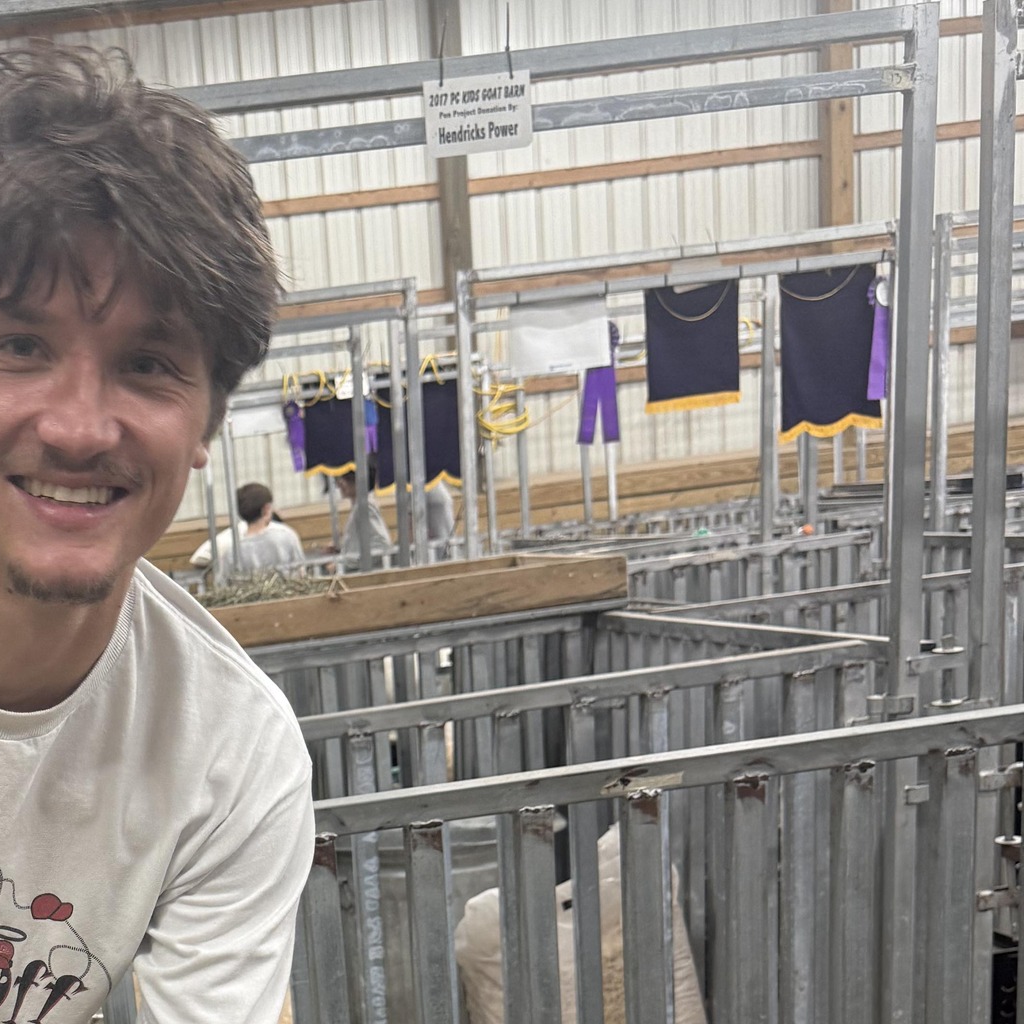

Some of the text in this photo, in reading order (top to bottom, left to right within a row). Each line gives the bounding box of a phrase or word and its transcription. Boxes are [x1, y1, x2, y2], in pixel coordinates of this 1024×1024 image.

[429, 84, 525, 108] 2017 PC KIDS GOAT BARN
[439, 111, 451, 120] Pen
[452, 109, 477, 118] Project
[477, 105, 507, 116] Donation
[438, 121, 519, 145] Hendricks Power
